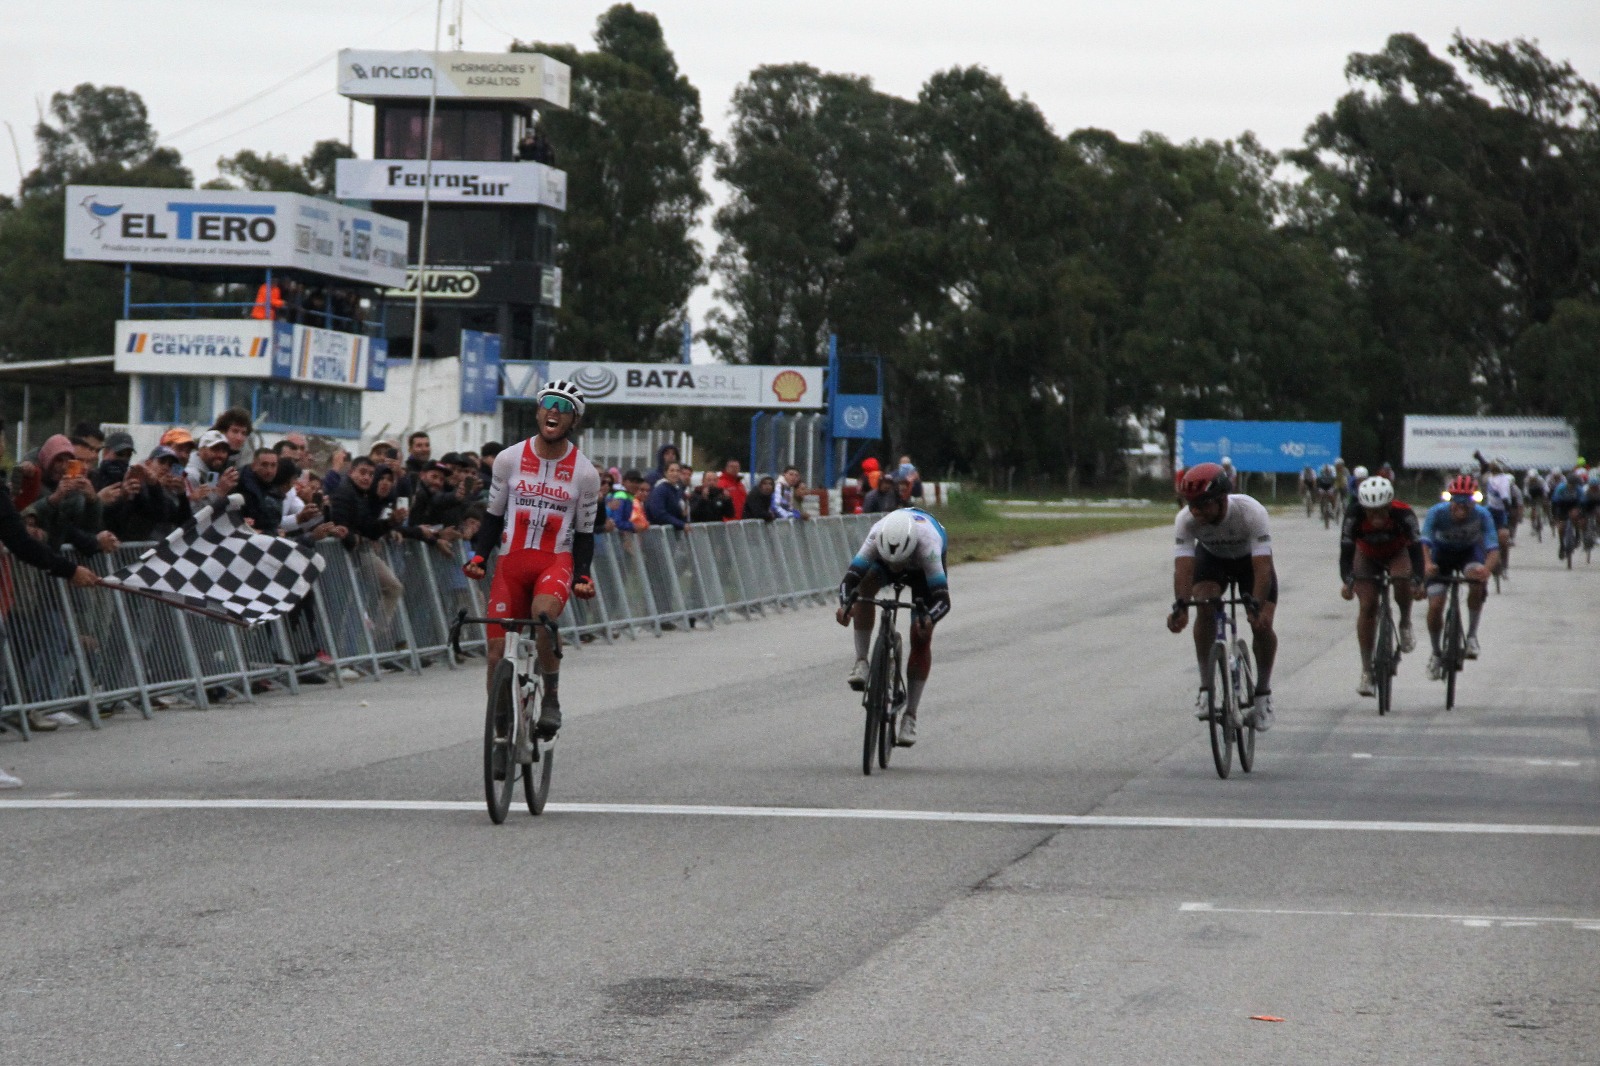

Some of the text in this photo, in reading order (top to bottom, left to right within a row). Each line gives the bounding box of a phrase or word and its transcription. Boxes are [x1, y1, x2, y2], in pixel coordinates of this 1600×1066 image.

[451, 64, 536, 73] HORMIGONES Y
[466, 77, 521, 86] ASFALTOS
[388, 166, 509, 196] FerroSur
[121, 213, 167, 239] EL
[167, 202, 276, 242] TERO
[152, 343, 244, 357] CENTRAL
[626, 369, 695, 388] BATA
[515, 497, 568, 513] LOULETANO
